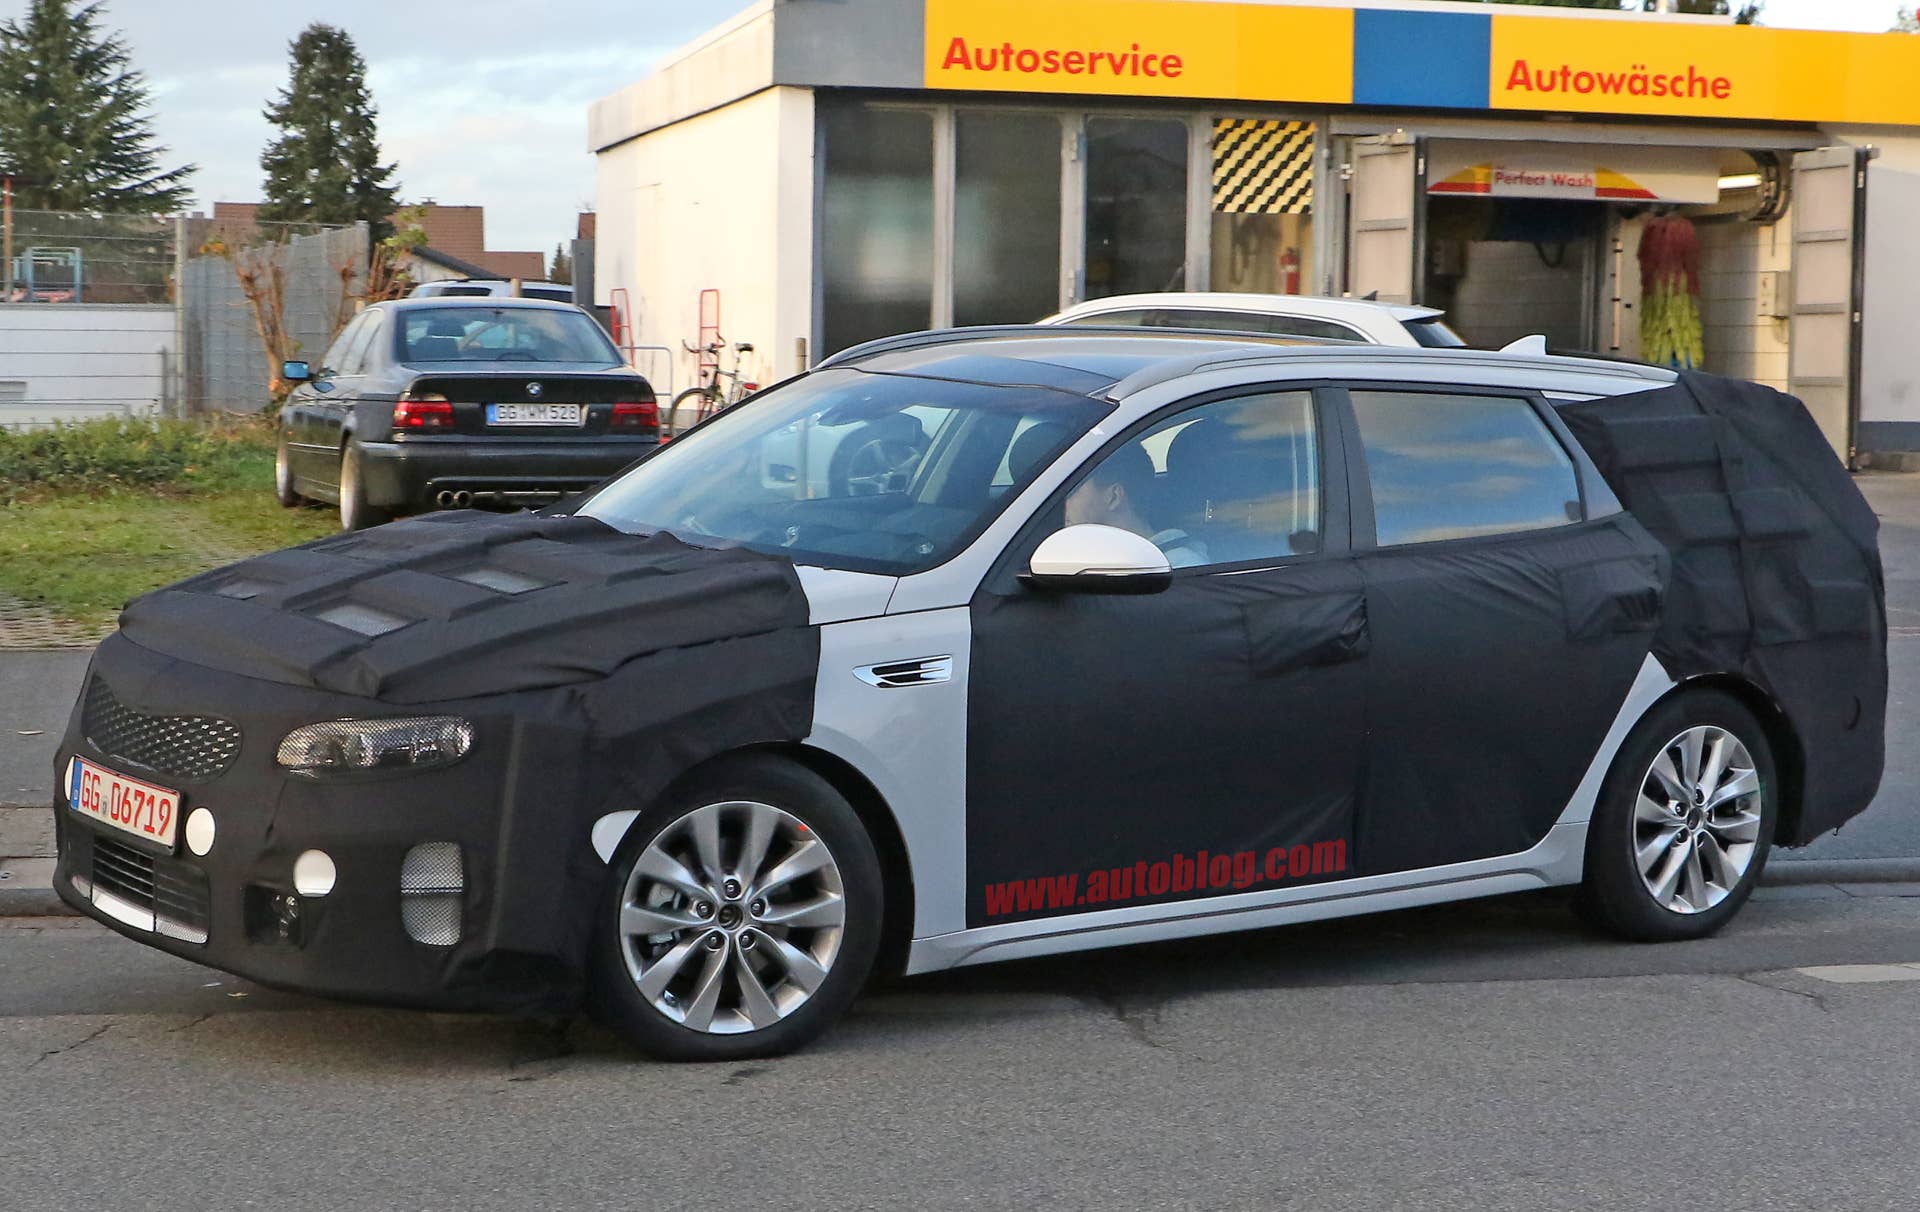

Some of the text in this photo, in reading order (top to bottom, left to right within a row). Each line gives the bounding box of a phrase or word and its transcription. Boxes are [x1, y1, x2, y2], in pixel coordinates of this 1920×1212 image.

[941, 37, 1182, 77] Autoservice
[1505, 59, 1731, 99] Autowäsche
[1494, 171, 1593, 187] Perfect Wash
